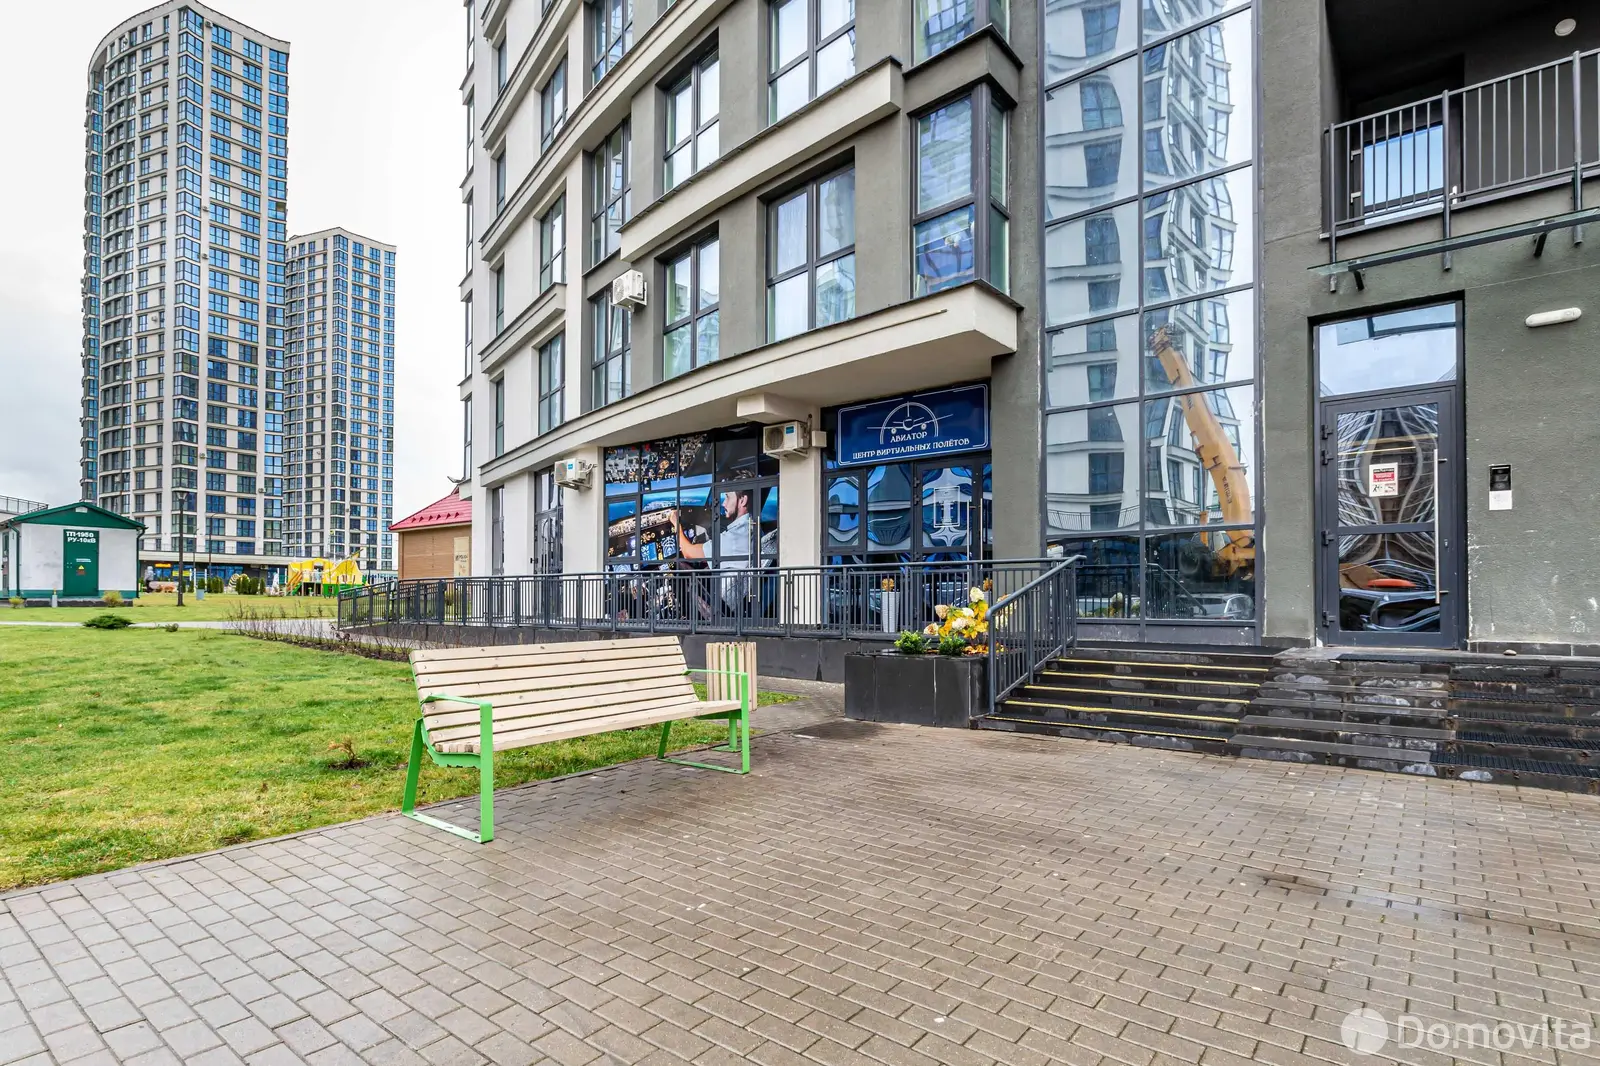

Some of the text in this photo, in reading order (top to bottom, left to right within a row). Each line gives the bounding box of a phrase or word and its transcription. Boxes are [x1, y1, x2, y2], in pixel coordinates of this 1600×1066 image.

[890, 432, 928, 443] АВИАТОР
[852, 438, 970, 460] ЦЕНТР ВИРТУАЛЬНЫХ ПОЛЁТОВ
